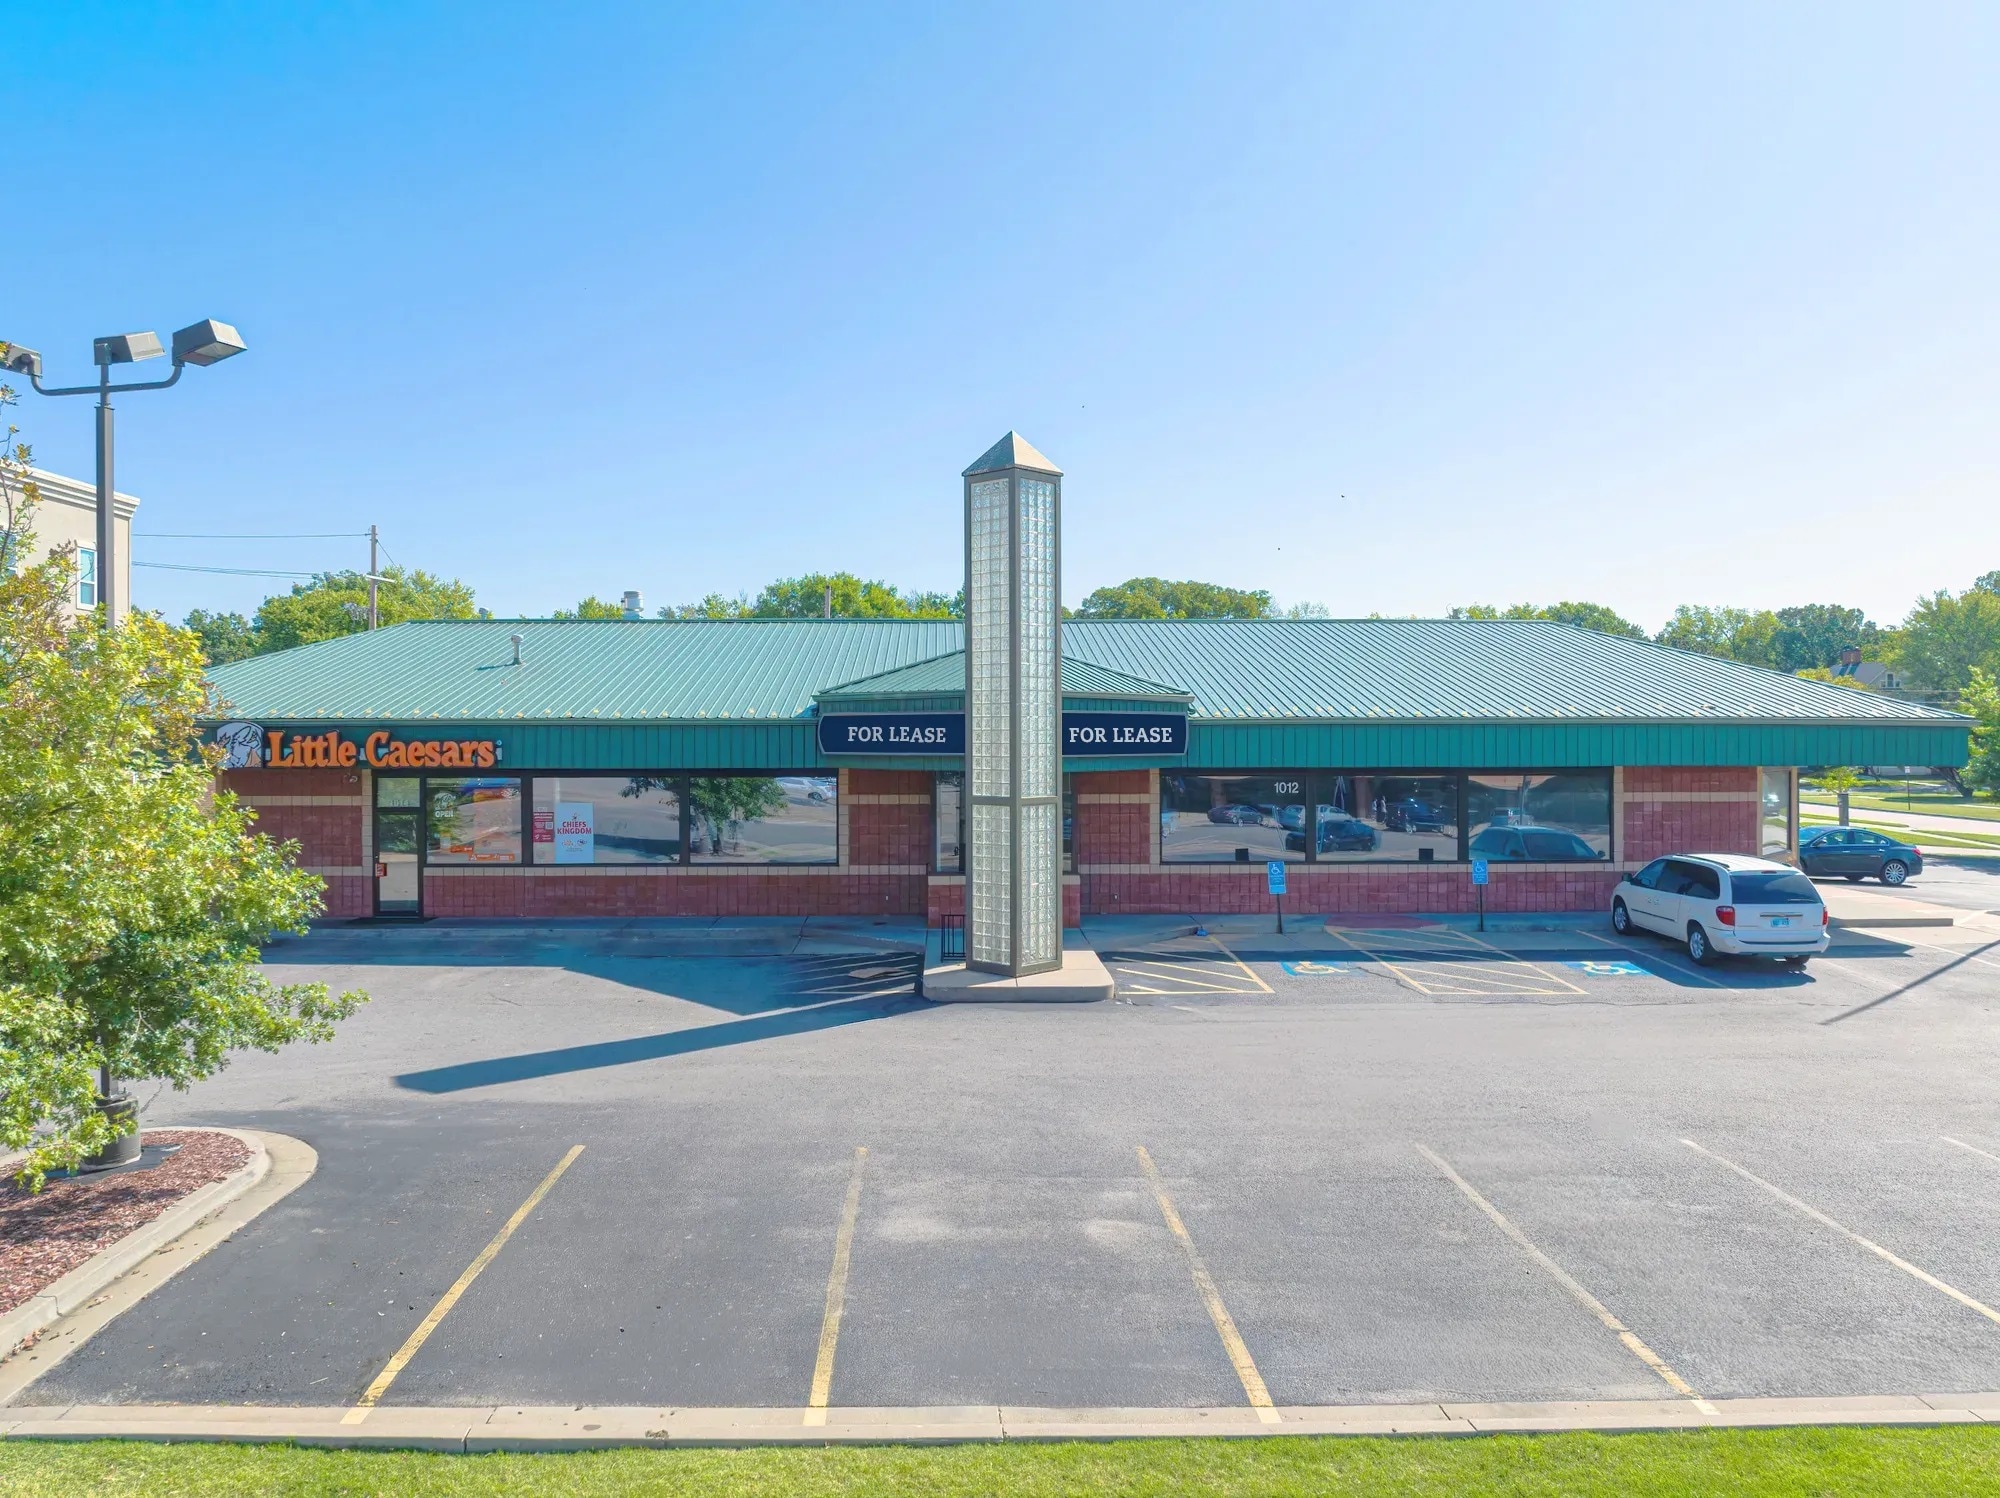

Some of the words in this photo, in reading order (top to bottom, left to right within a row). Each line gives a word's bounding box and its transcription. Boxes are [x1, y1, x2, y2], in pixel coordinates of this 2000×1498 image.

[847, 726, 883, 742] FOR
[888, 726, 946, 743] LEASE
[1068, 727, 1107, 743] FOR
[1112, 726, 1173, 743] LEASE
[267, 731, 356, 768] Little
[365, 730, 494, 768] Caesars
[1273, 781, 1300, 794] 1012
[434, 810, 454, 818] OPEN
[557, 827, 592, 835] KINGDOM
